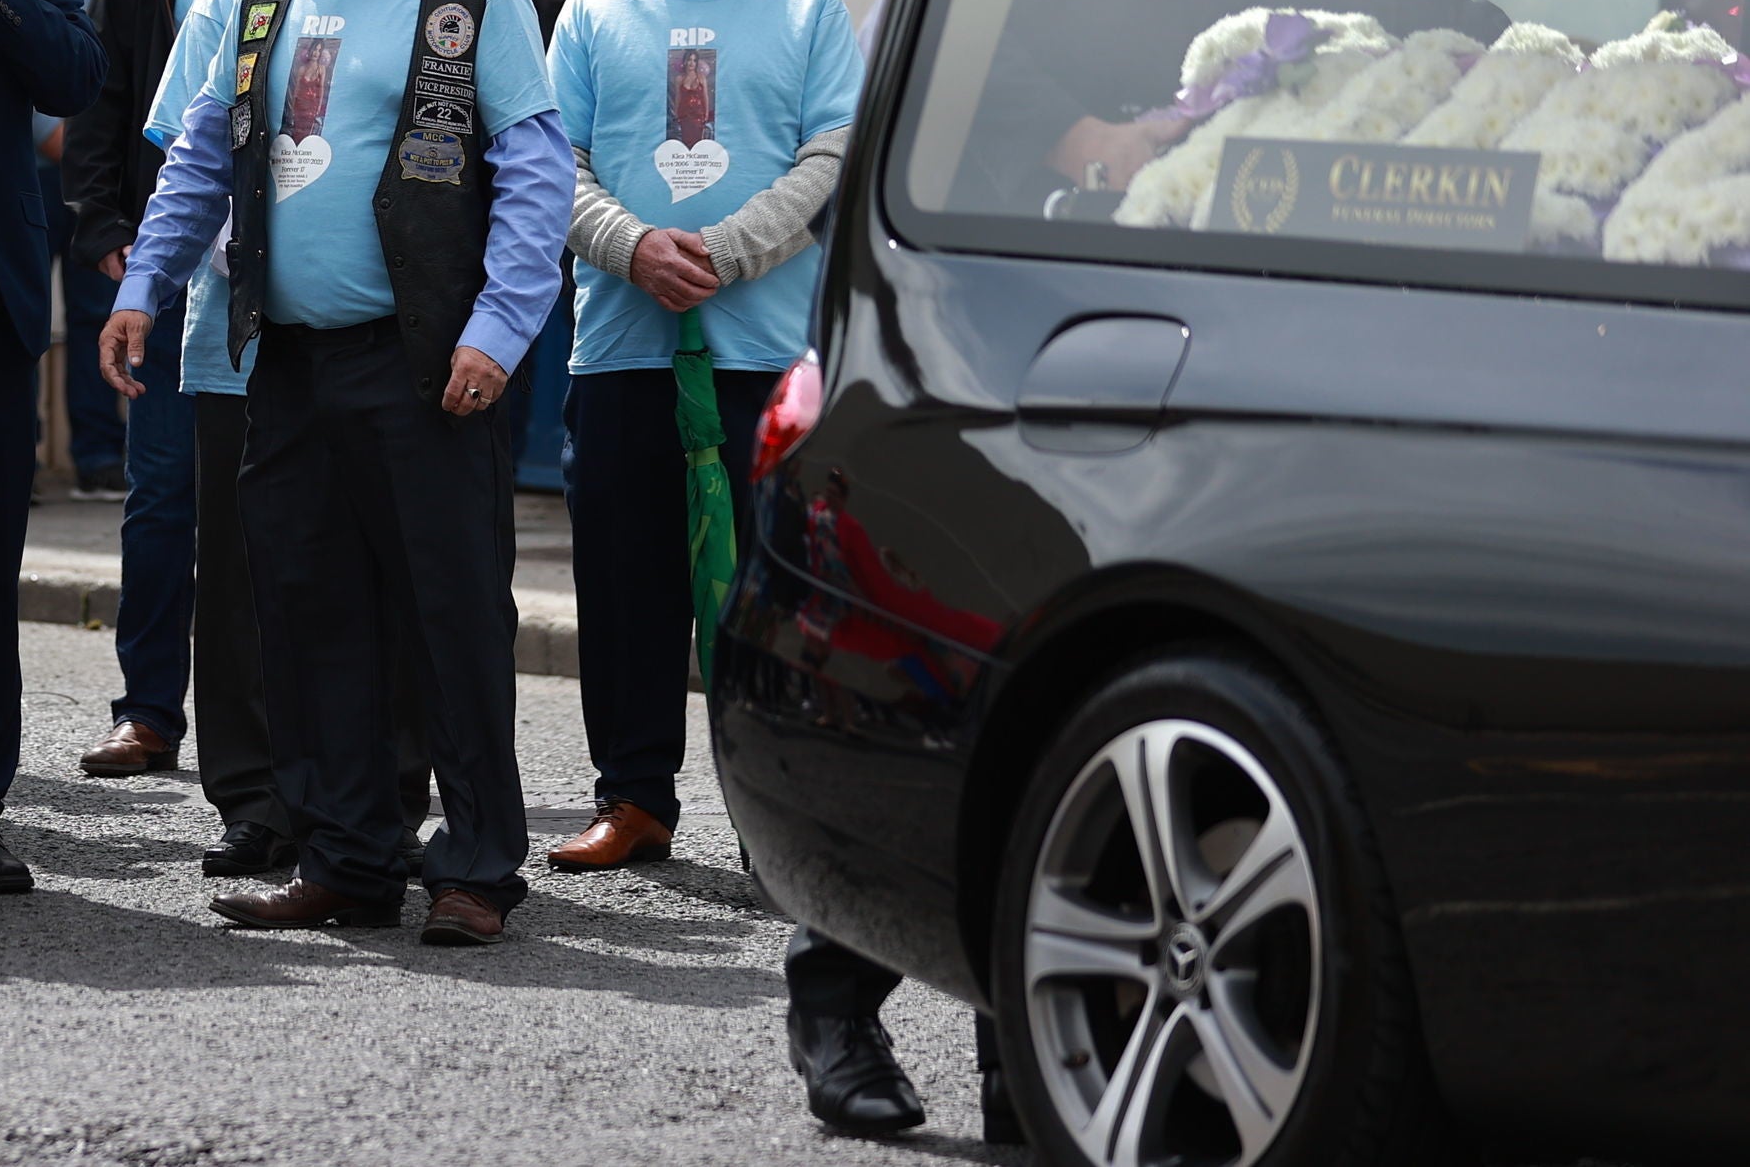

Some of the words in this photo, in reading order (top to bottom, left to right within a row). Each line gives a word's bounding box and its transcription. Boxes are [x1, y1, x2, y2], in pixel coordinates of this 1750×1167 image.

[434, 6, 469, 20] CENTURIONS
[301, 15, 346, 35] RIP
[427, 30, 458, 55] MOTORCYCLE
[460, 34, 471, 50] CLUB
[670, 27, 715, 46] RIP
[424, 60, 472, 76] FRANKIE
[437, 107, 452, 120] 22
[423, 133, 445, 142] MCC
[1329, 154, 1512, 209] CLERKIN
[1331, 205, 1400, 225] FUNERAL
[1405, 208, 1496, 230] DIRECTORS
